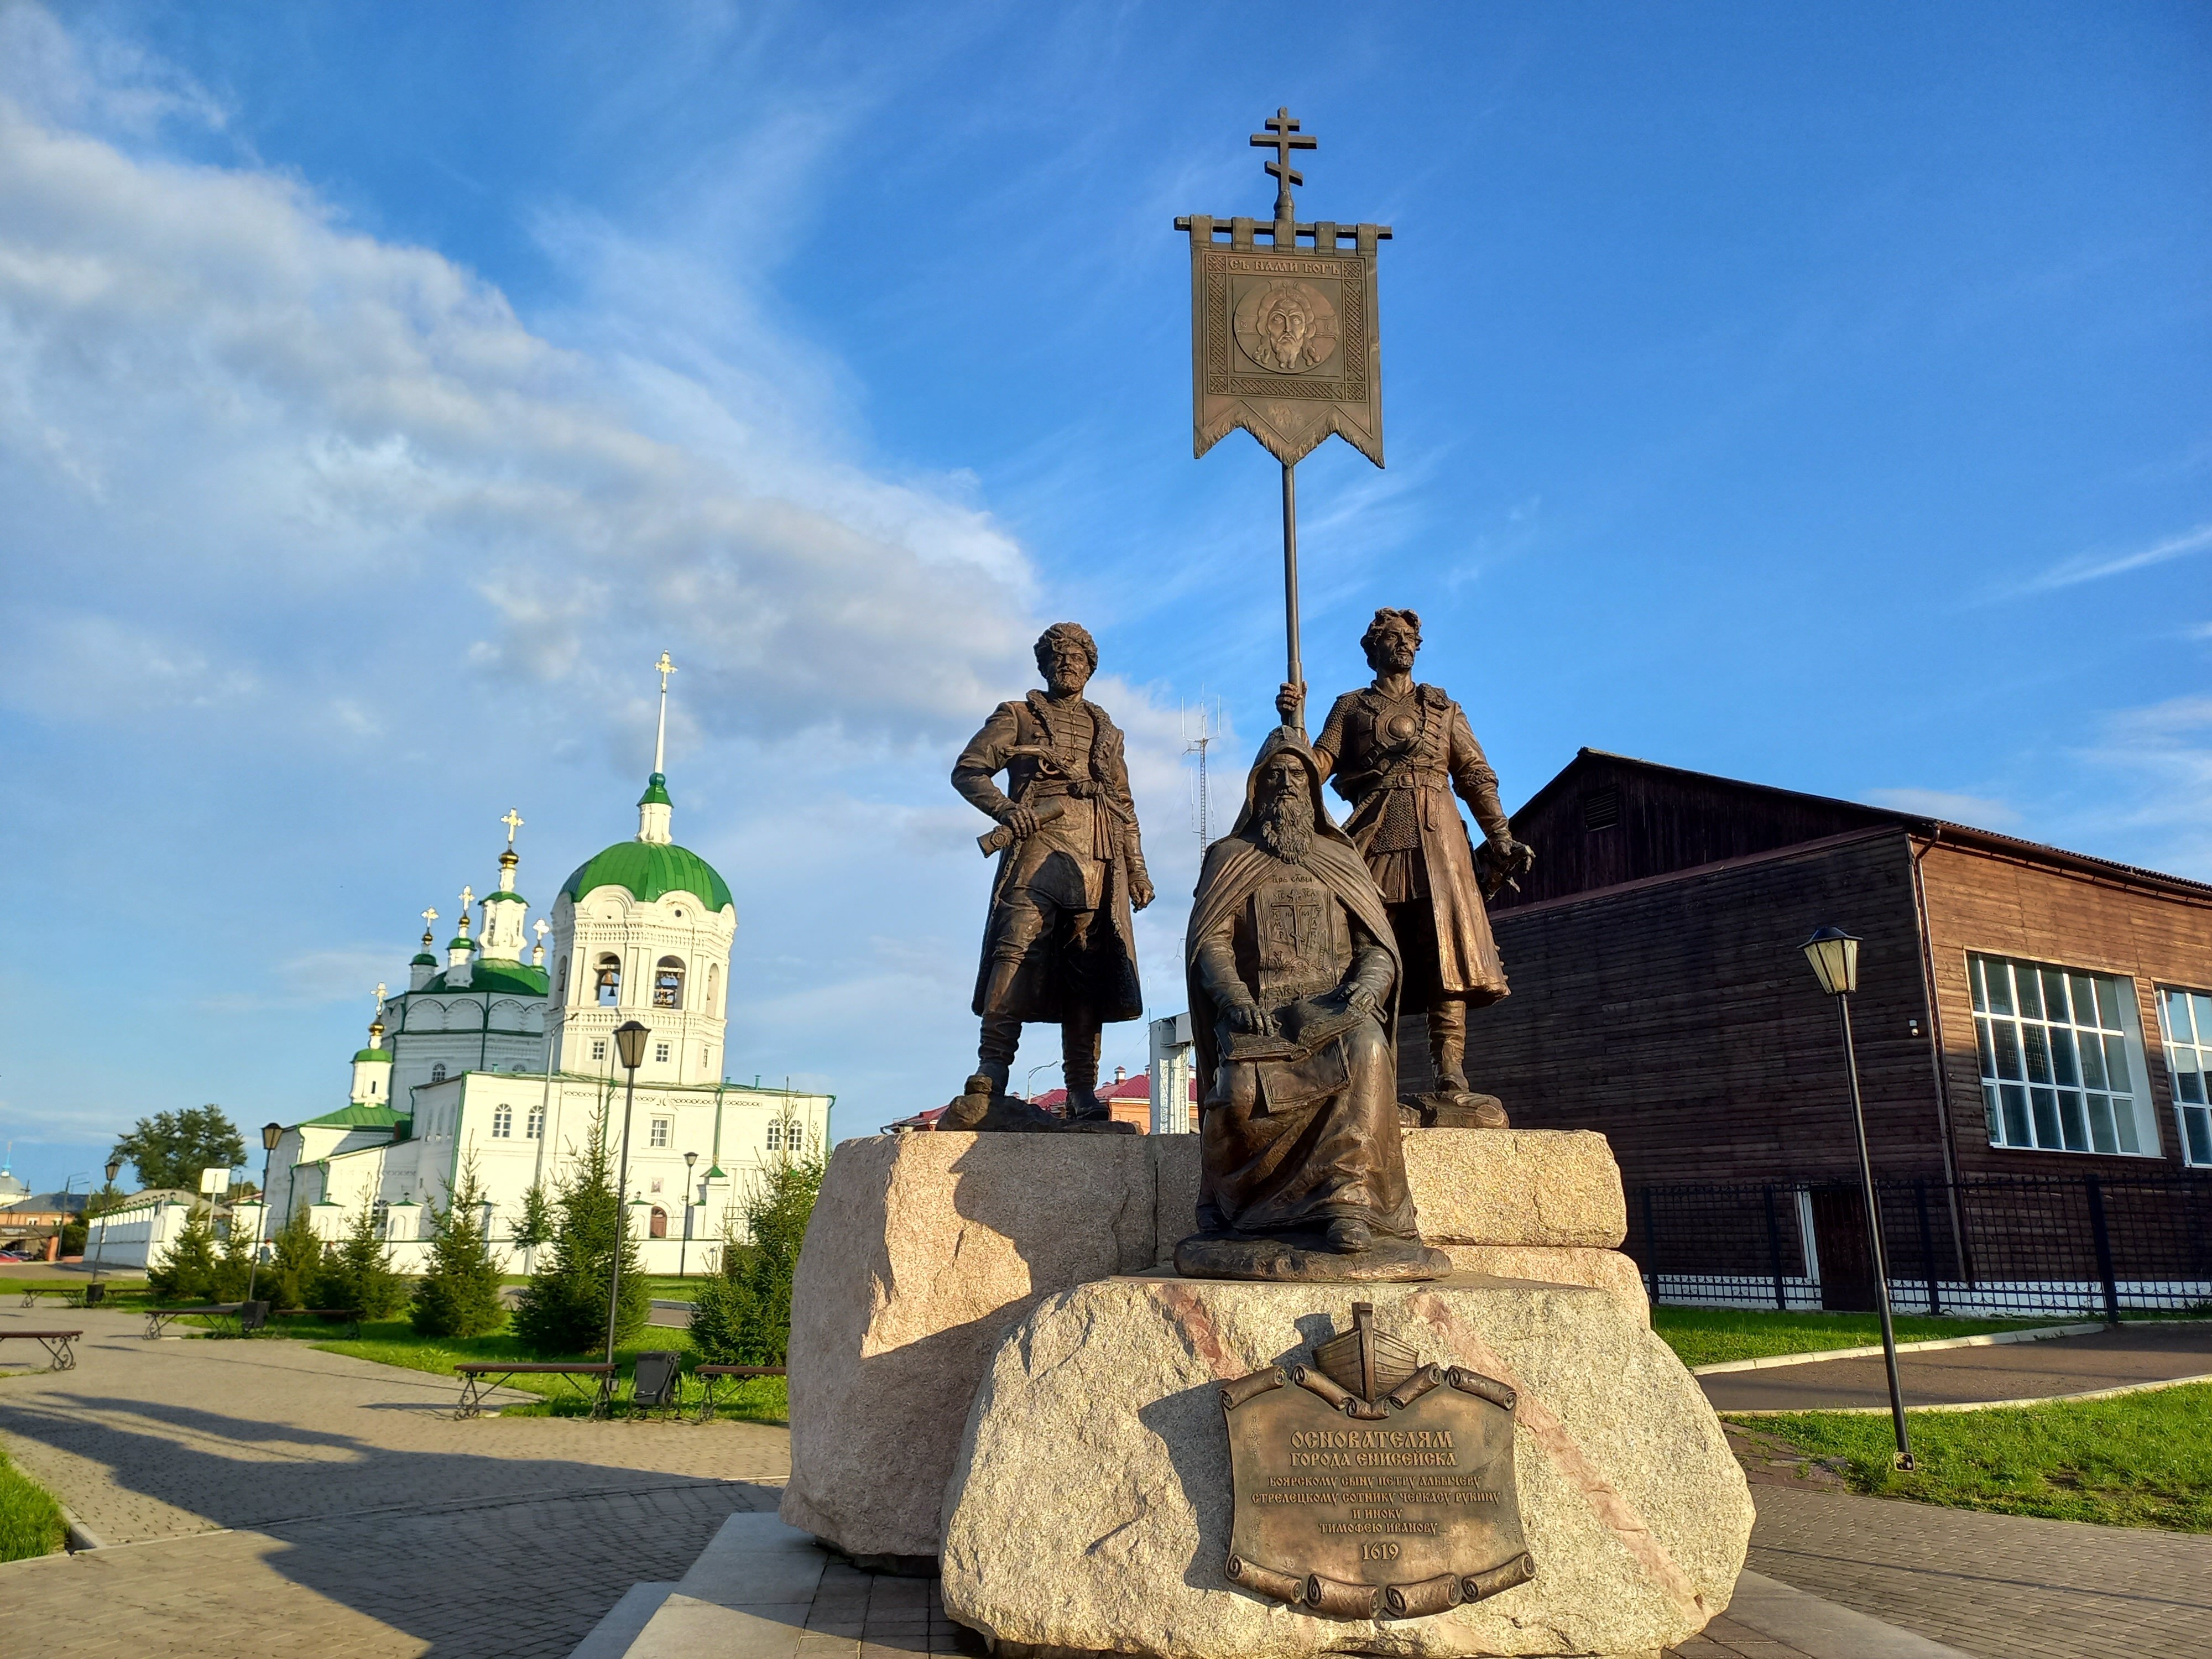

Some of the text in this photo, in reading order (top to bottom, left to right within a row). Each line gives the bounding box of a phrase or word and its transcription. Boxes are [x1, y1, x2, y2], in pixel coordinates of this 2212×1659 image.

[1229, 259, 1250, 270] СЪ
[1303, 263, 1339, 275] БОГЪ
[1290, 1431, 1455, 1449] ОСНОВАТЕЛЯМ
[1290, 1449, 1457, 1469] ГОРОДА ЕНИСЕЙСКА
[1268, 1476, 1481, 1489] БОЯРСКОМУ СЫНУ ПЕТРУ АЛБЫЧЕВУ
[1251, 1492, 1500, 1506] СТРЕЛЕЦКОМУ СОТНИКУ ЧЕРКАСУ РУКИНУ
[1352, 1509, 1404, 1521] И ИНОКУ
[1318, 1522, 1438, 1535] ТИМОФЕЮ ИВАНОВУ
[1362, 1542, 1399, 1560] 1619
